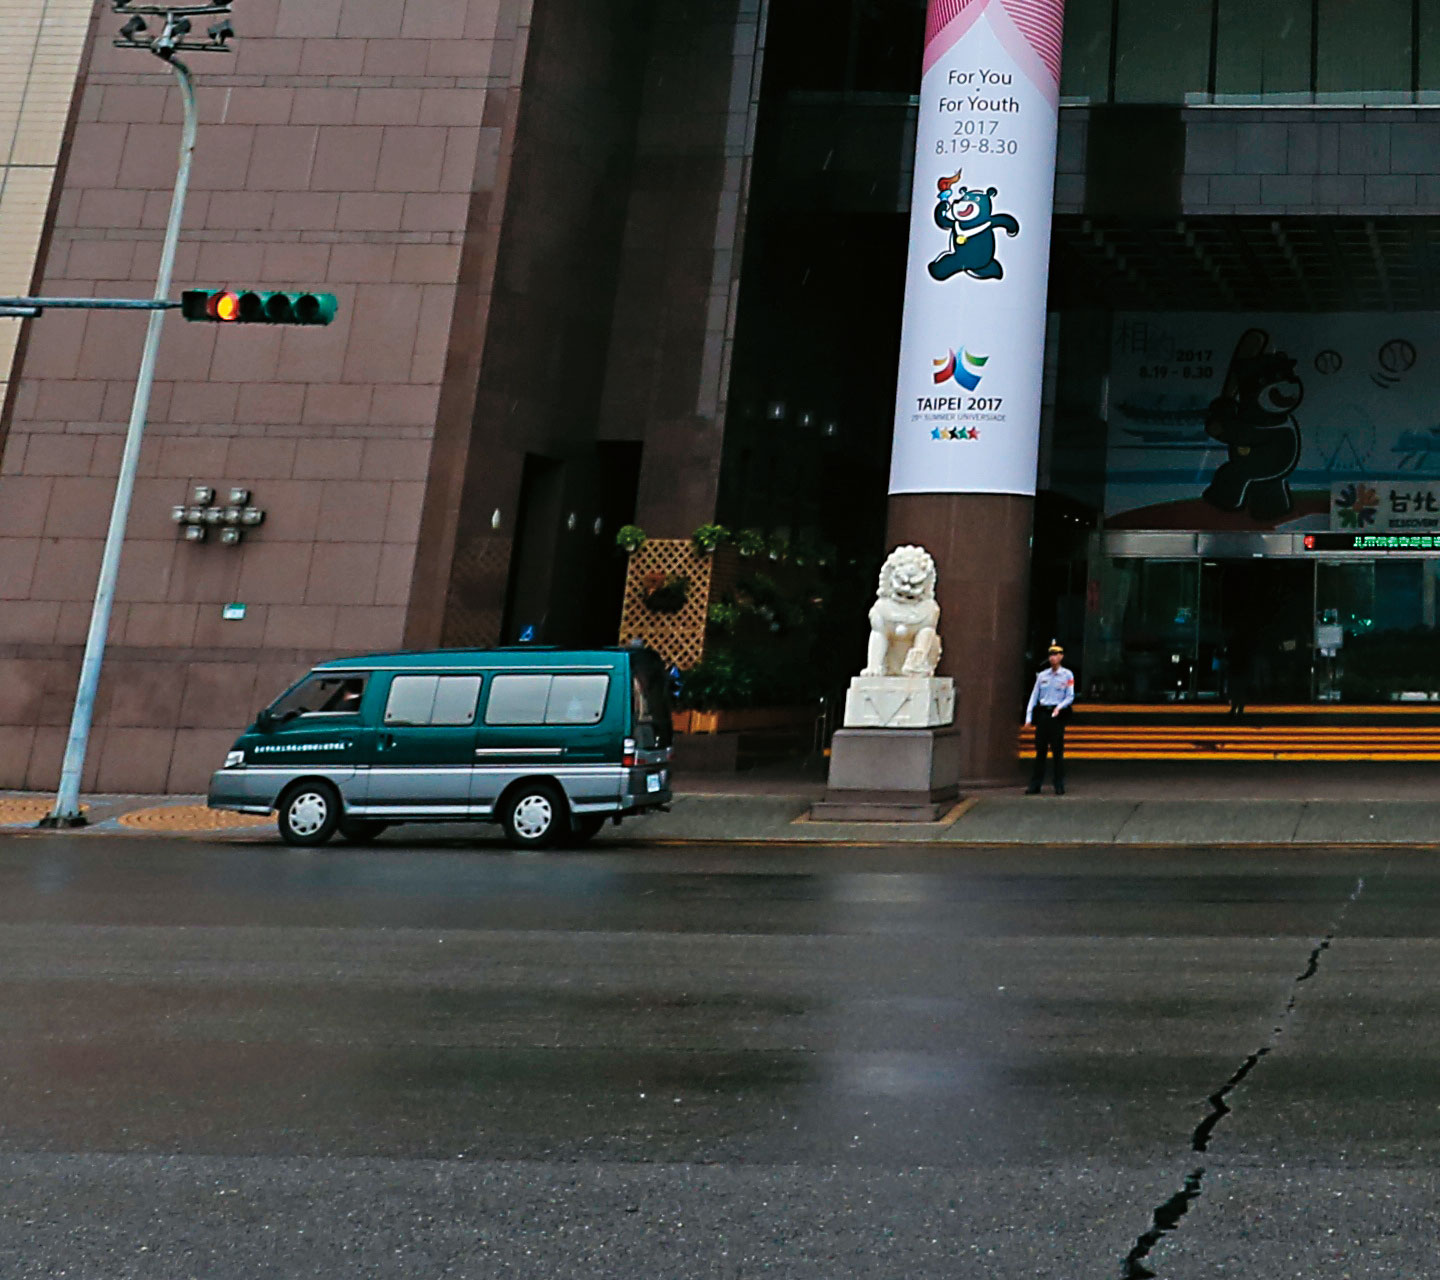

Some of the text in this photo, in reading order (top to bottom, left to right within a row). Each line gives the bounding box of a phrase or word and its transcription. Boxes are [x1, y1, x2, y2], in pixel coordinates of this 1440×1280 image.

[949, 69, 1012, 85] For You
[939, 96, 1019, 113] For Youth
[954, 121, 999, 135] 2017
[935, 138, 1018, 155] 8.19-8.30
[1176, 350, 1213, 362] 2017
[917, 397, 1003, 411] TAIPEI 2017
